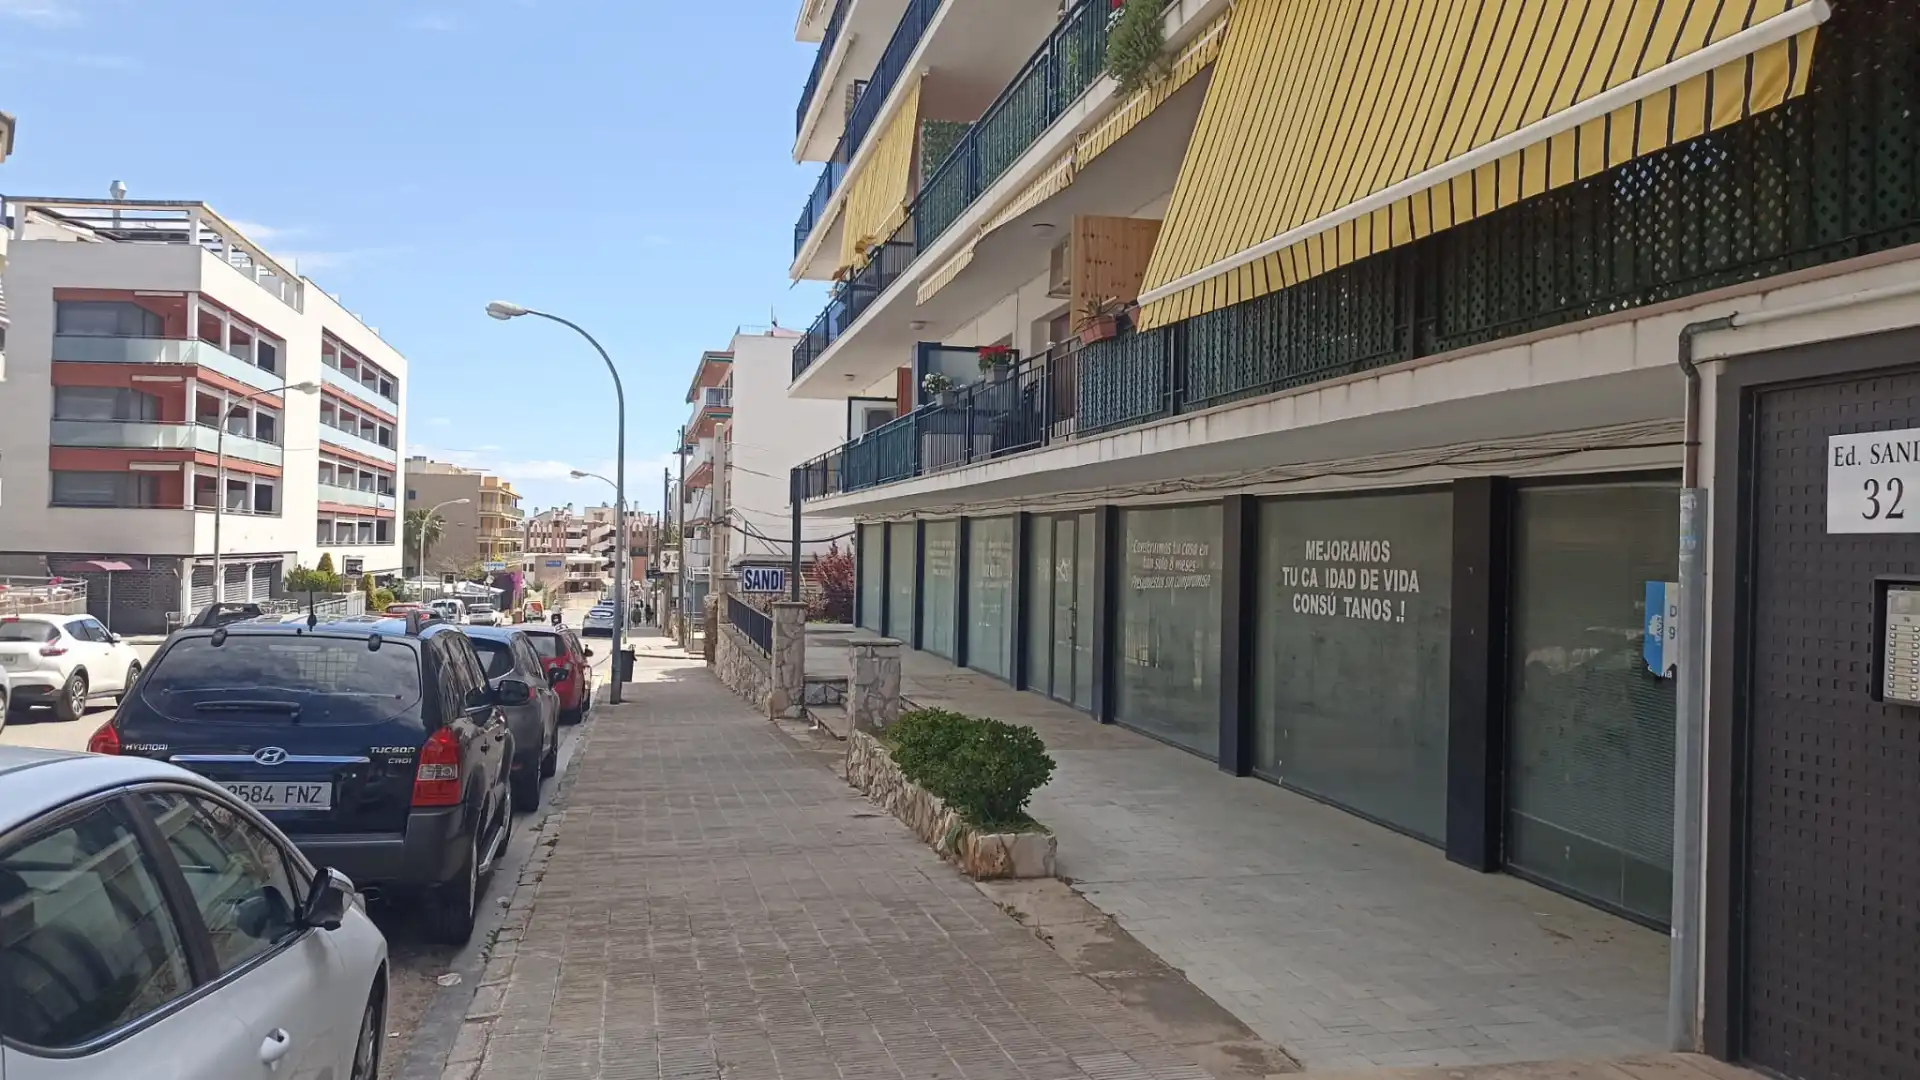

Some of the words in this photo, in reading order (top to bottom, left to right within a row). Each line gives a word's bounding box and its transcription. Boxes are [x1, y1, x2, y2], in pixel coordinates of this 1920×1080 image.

[1834, 445, 1861, 467] Ed.
[1862, 477, 1905, 520] 32
[1305, 540, 1391, 563] MEJORAMOS
[745, 569, 783, 590] SANDI
[1282, 566, 1298, 587] TU
[1360, 568, 1379, 591] DE
[1383, 569, 1420, 593] VIDA
[126, 743, 168, 751] HYUNDAI
[370, 746, 416, 754] TUCSON
[285, 785, 322, 804] FNZ
